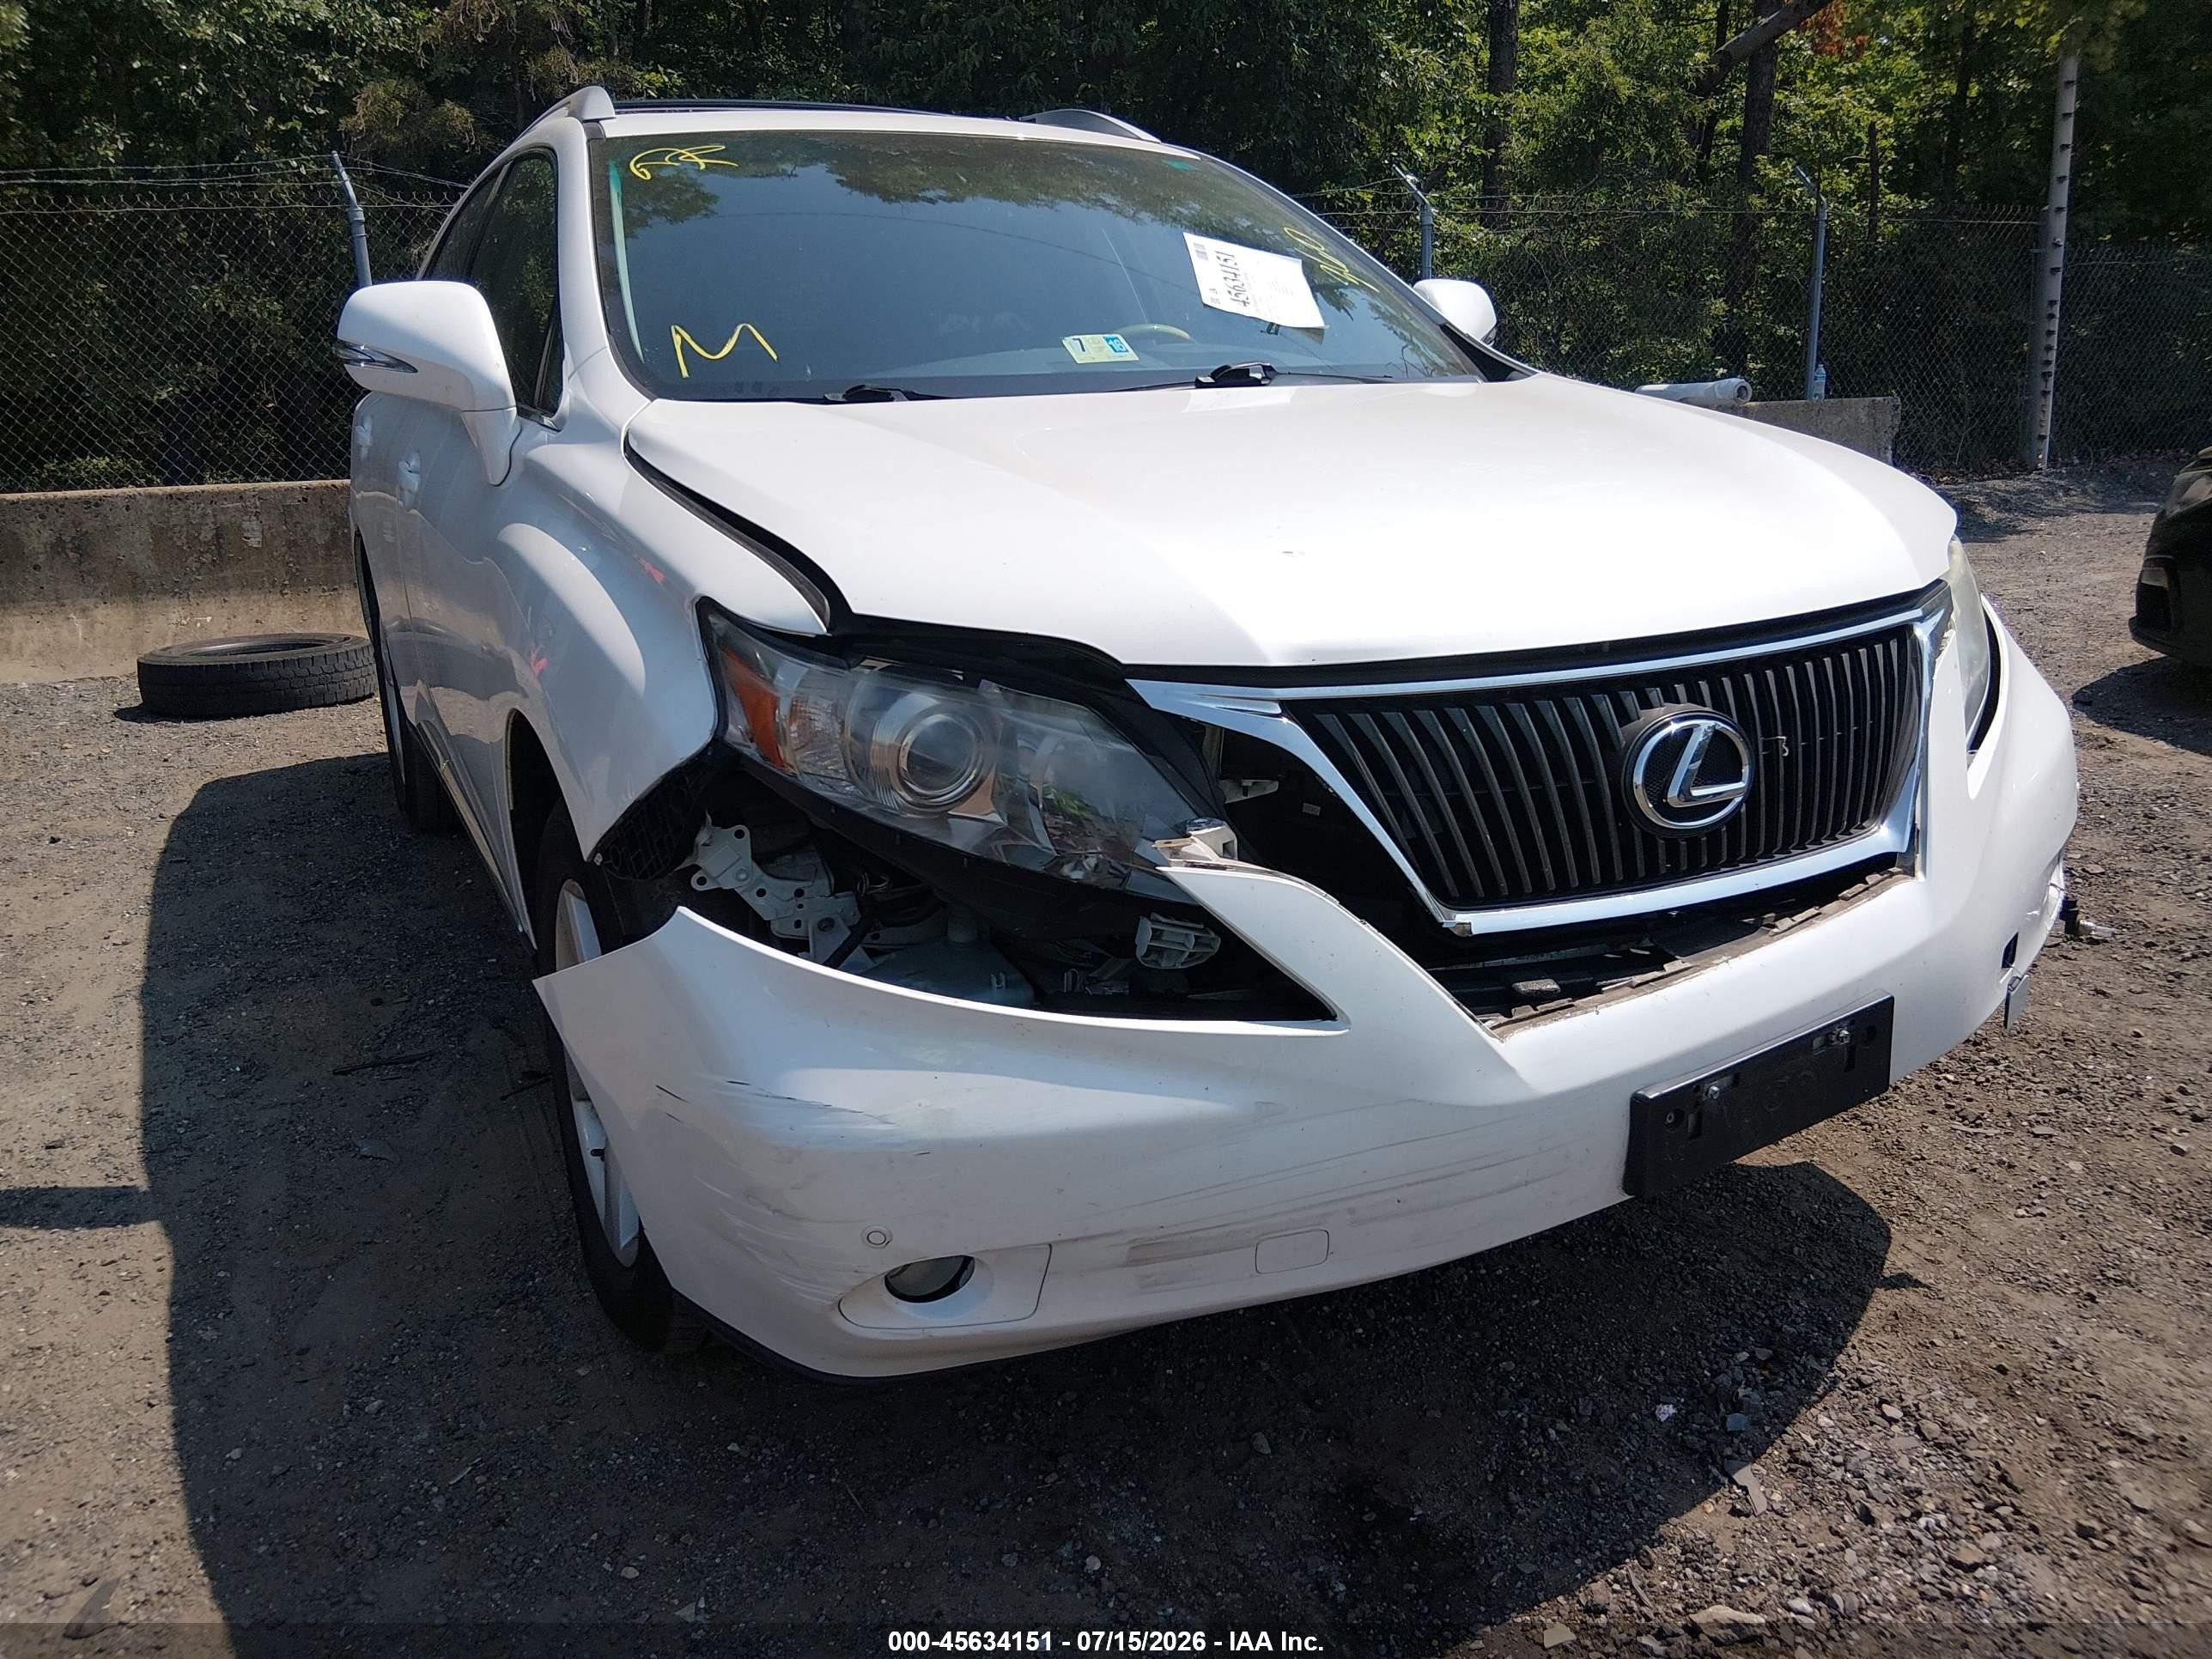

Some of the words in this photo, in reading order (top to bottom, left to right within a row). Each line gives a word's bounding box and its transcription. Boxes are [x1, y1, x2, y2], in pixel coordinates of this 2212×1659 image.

[1213, 250, 1251, 307] 45634151
[670, 322, 779, 379] M
[1072, 337, 1086, 353] 7
